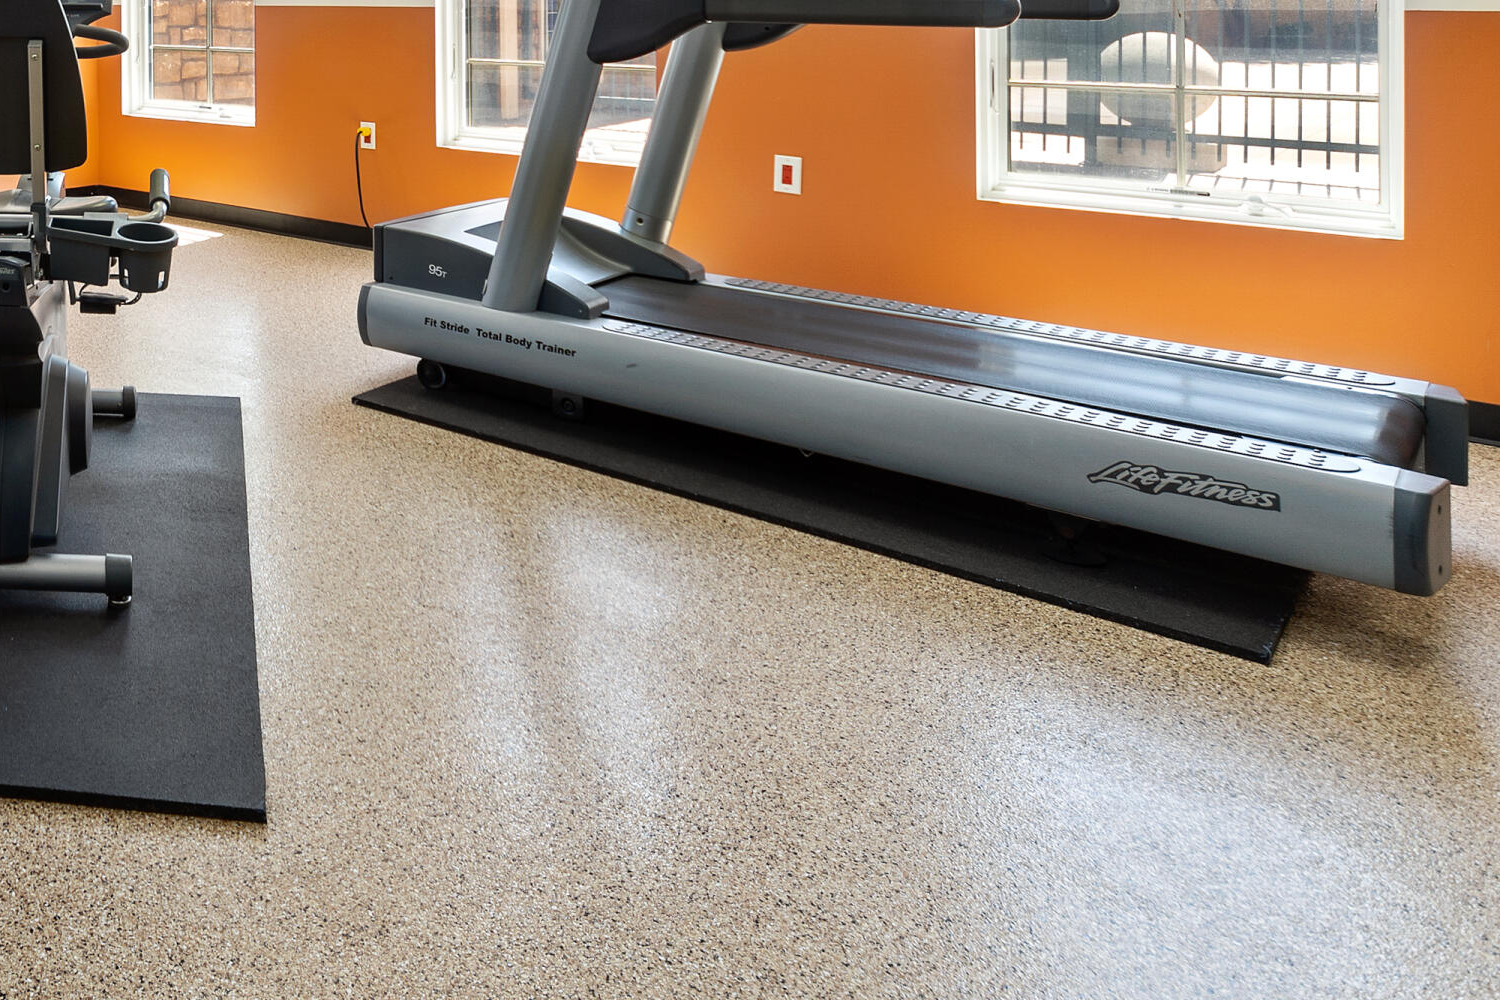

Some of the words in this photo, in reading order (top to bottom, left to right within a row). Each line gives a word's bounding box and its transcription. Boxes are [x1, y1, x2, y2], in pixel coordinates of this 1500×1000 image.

[424, 317, 437, 328] Fit
[440, 320, 470, 335] Stride
[476, 327, 502, 342] Total
[505, 334, 533, 350] Body
[536, 340, 577, 358] Trainer
